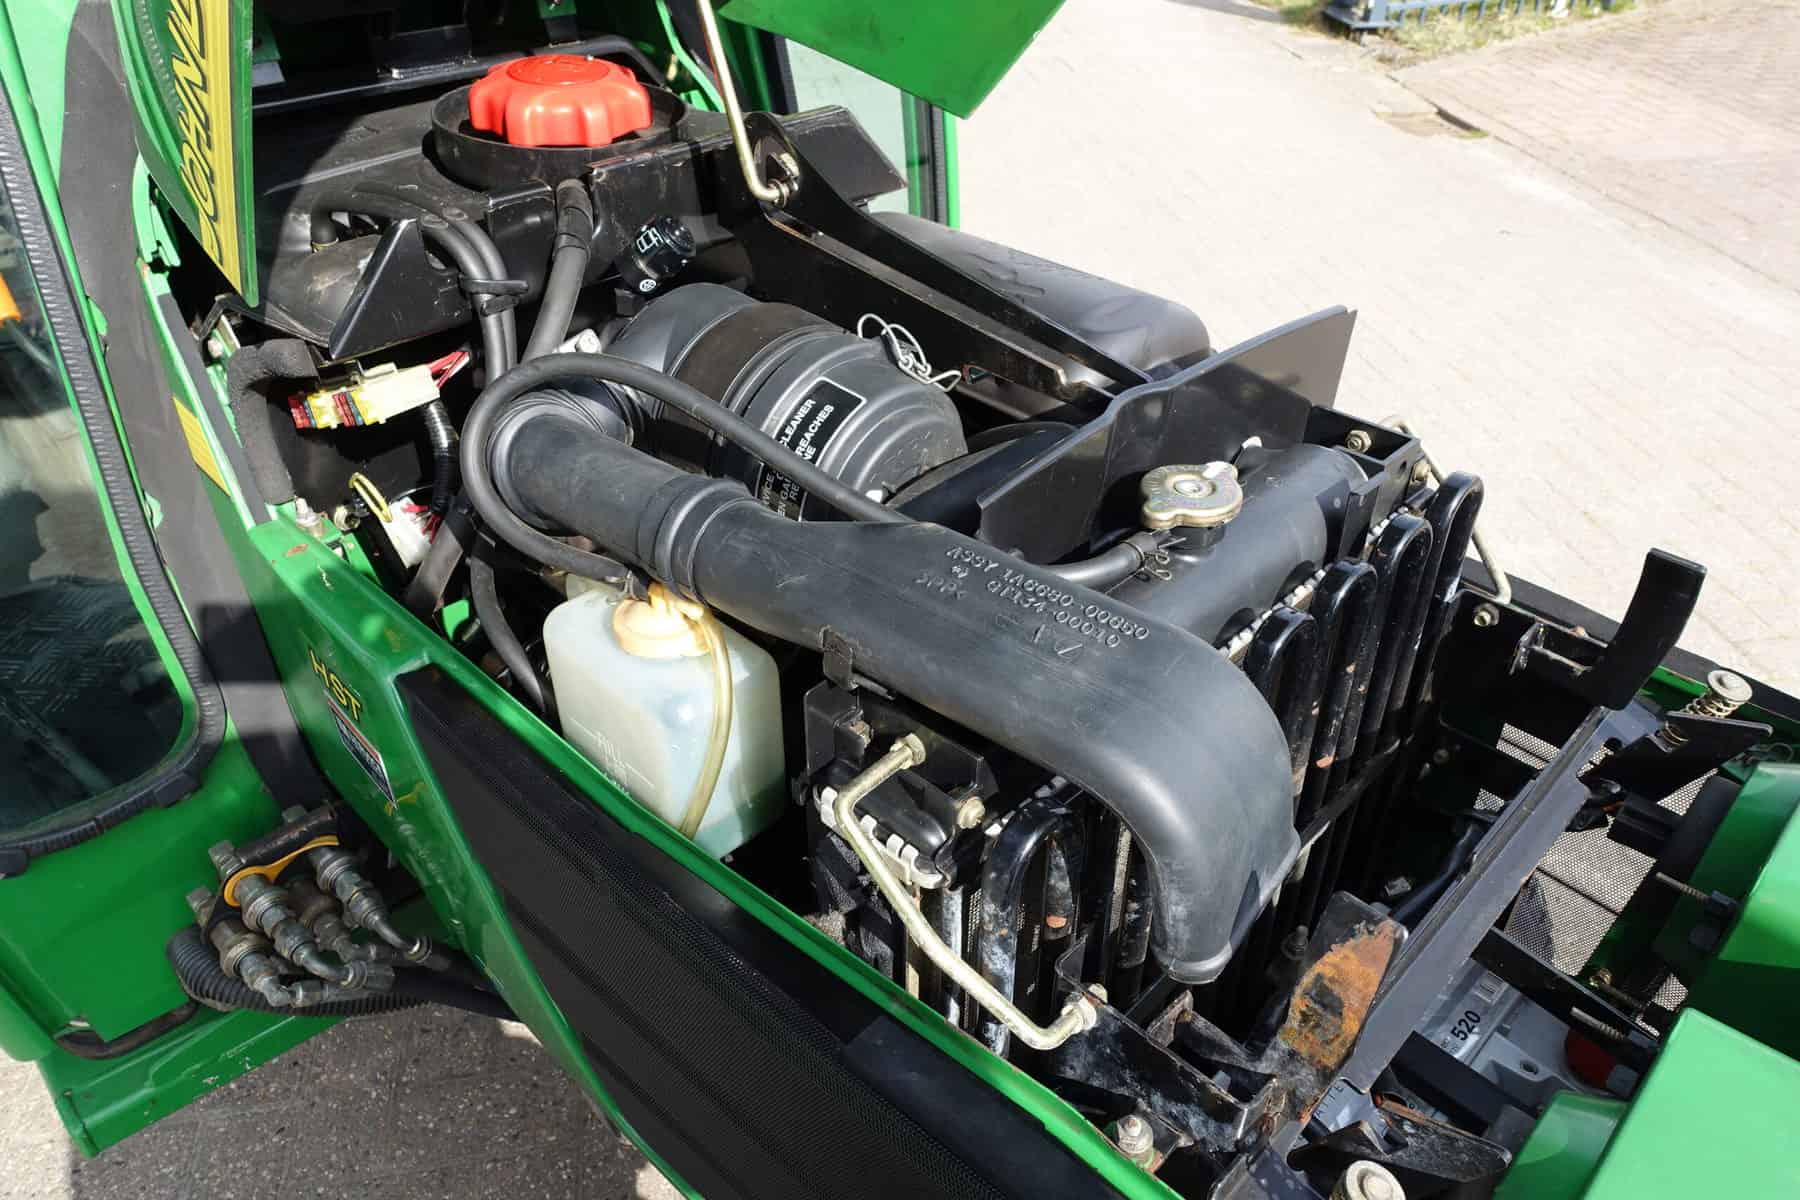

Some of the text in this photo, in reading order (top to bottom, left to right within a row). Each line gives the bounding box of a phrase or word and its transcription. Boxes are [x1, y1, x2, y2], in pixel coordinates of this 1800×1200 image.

[795, 404, 835, 456] REACHES
[309, 649, 361, 721] HST
[1450, 1010, 1481, 1041] 520
